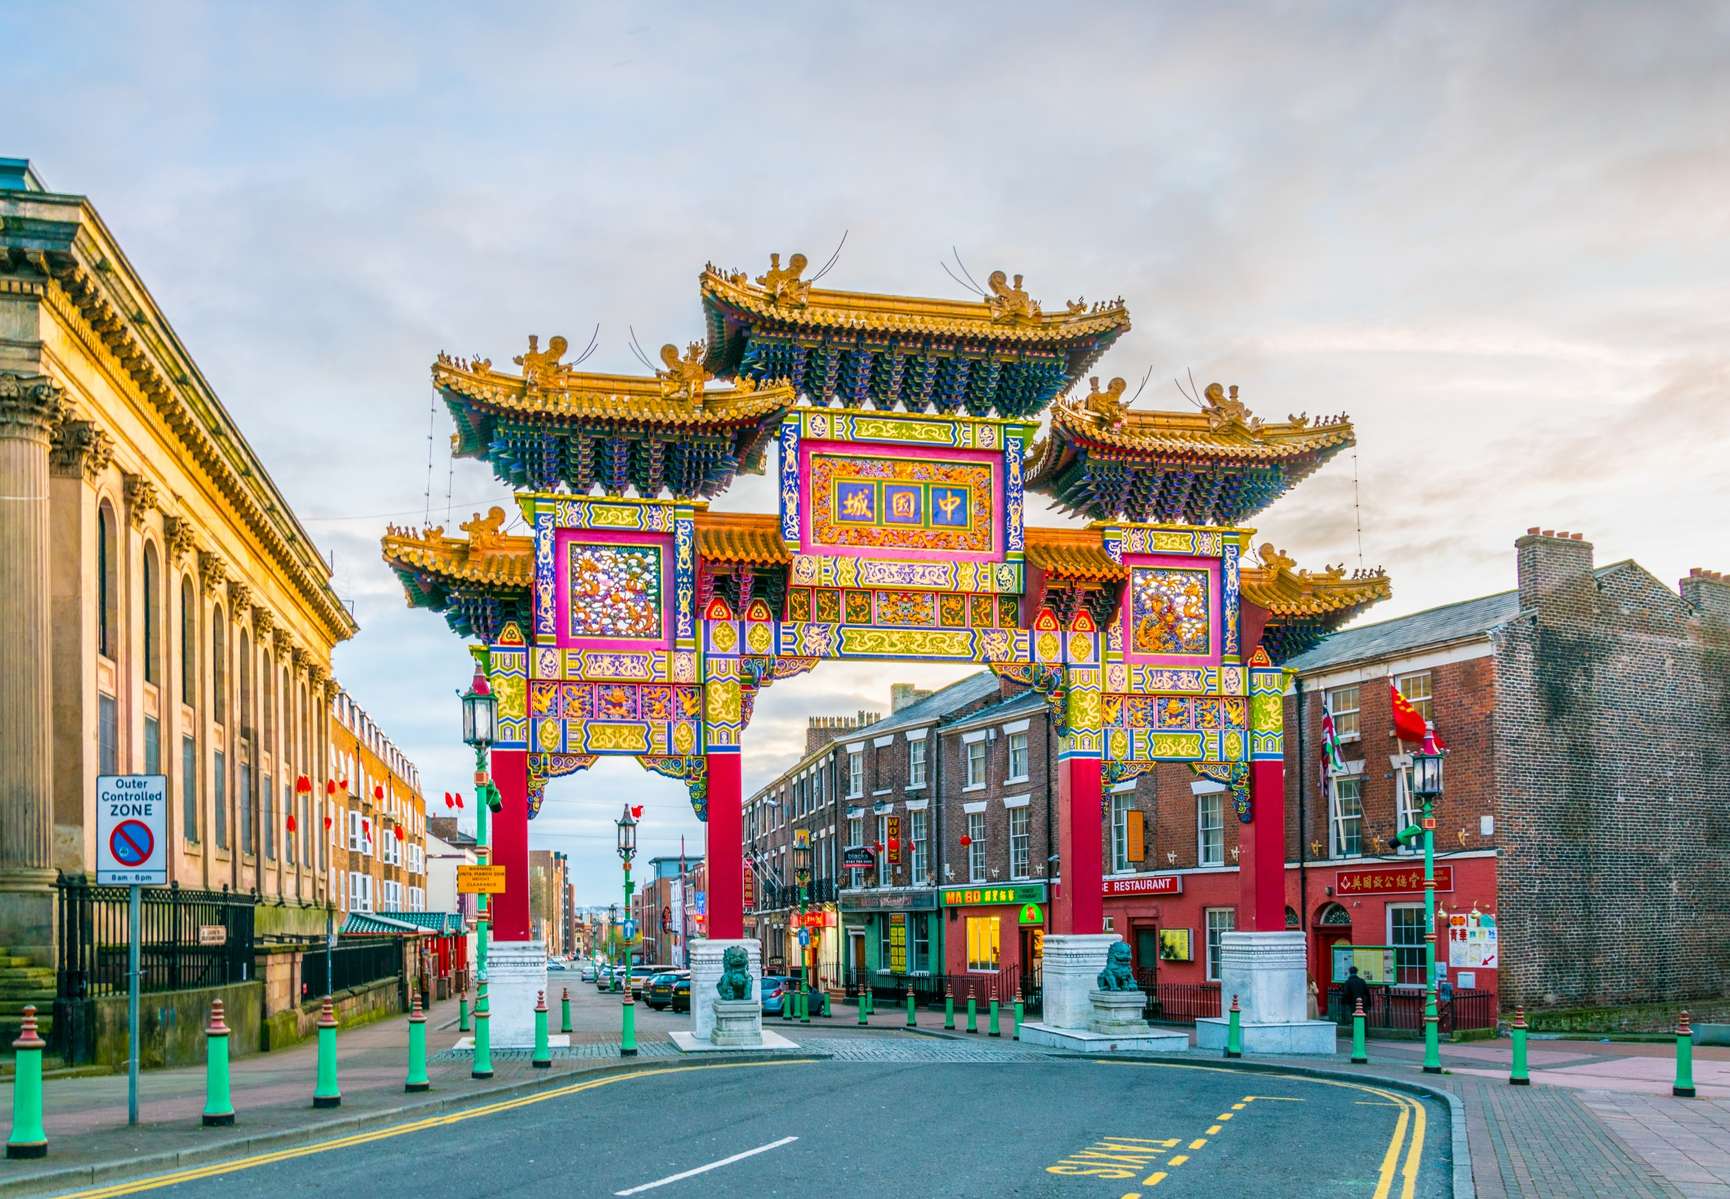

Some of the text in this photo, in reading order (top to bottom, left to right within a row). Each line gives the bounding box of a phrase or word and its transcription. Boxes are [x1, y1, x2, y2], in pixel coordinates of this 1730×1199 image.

[115, 778, 148, 789] Outer
[101, 791, 162, 801] Controlled
[110, 804, 153, 816] ZONE
[1114, 878, 1172, 892] RESTAURANT
[946, 891, 962, 904] MA
[1045, 1136, 1182, 1179] TAXIS
